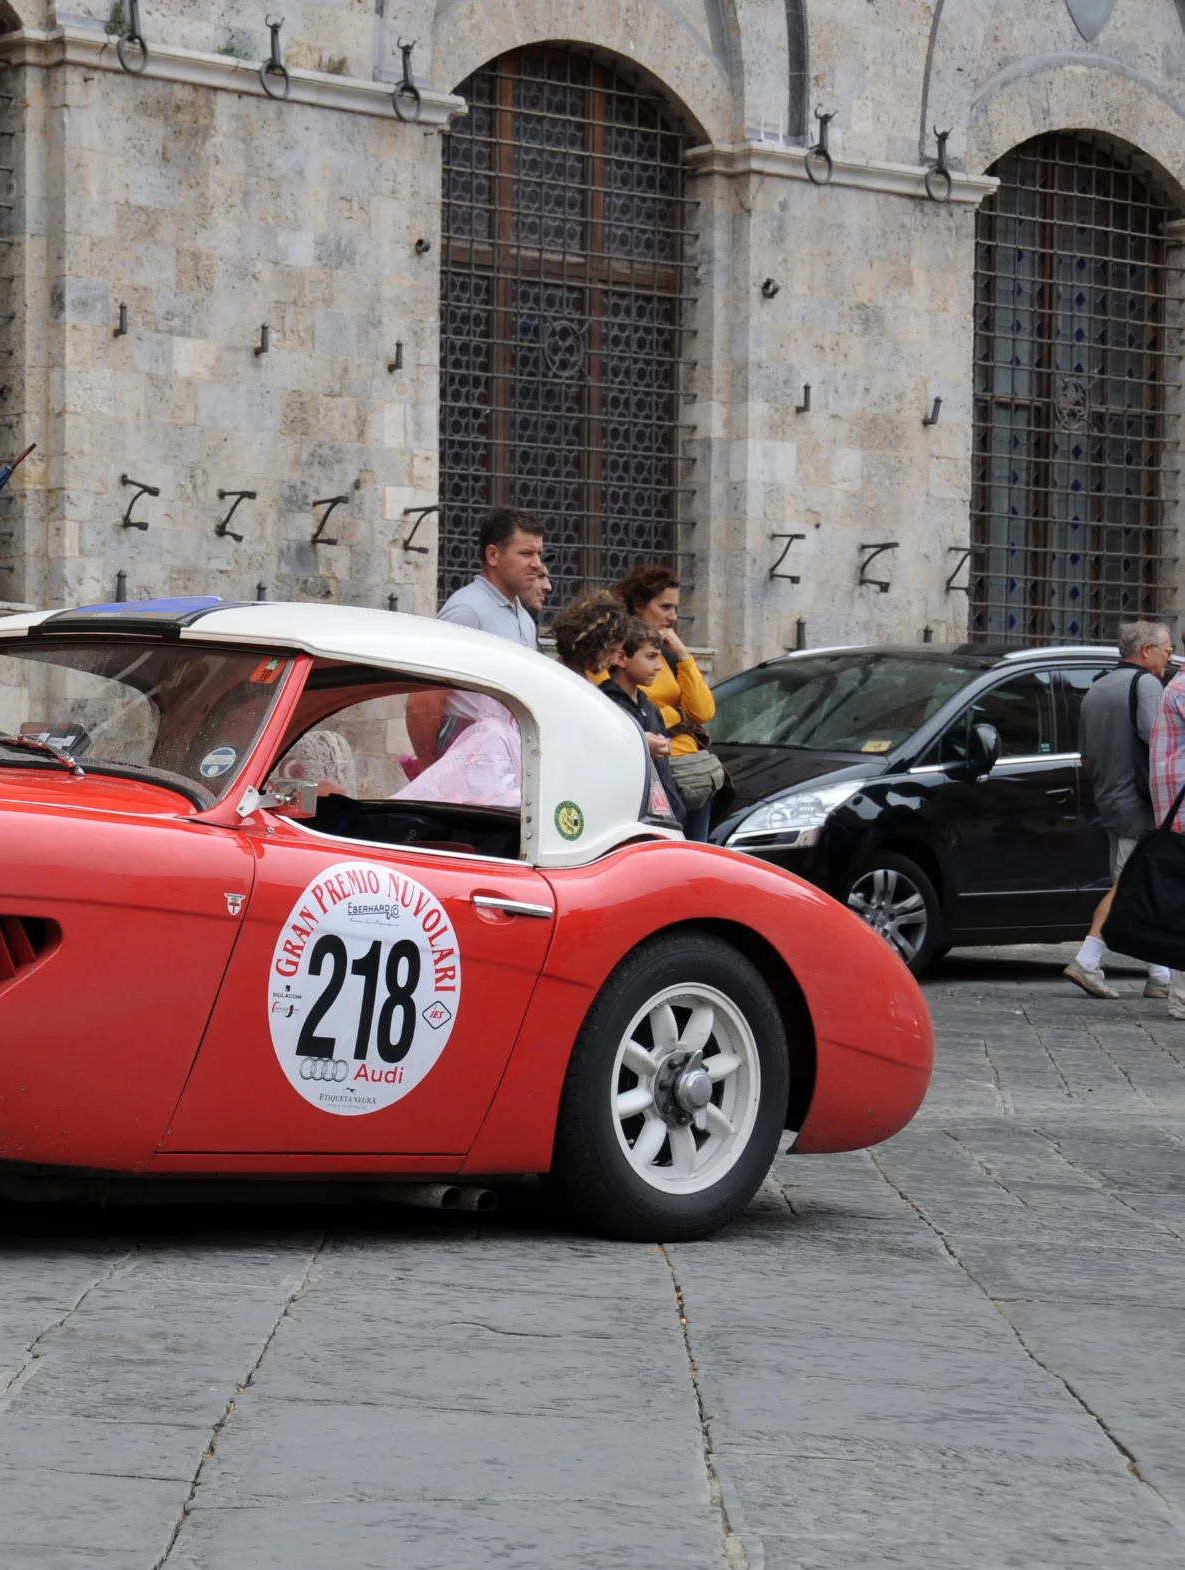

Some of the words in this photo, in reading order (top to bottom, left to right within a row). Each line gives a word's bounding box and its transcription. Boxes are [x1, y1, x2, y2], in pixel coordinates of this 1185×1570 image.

[275, 905, 319, 977] GRAN
[311, 869, 380, 915] PREMIO
[387, 872, 456, 993] NUVOLARI
[295, 934, 421, 1063] 218
[319, 1093, 353, 1104] ETIQUETA
[354, 1096, 377, 1105] NEGRA
[353, 1063, 405, 1084] Audi
